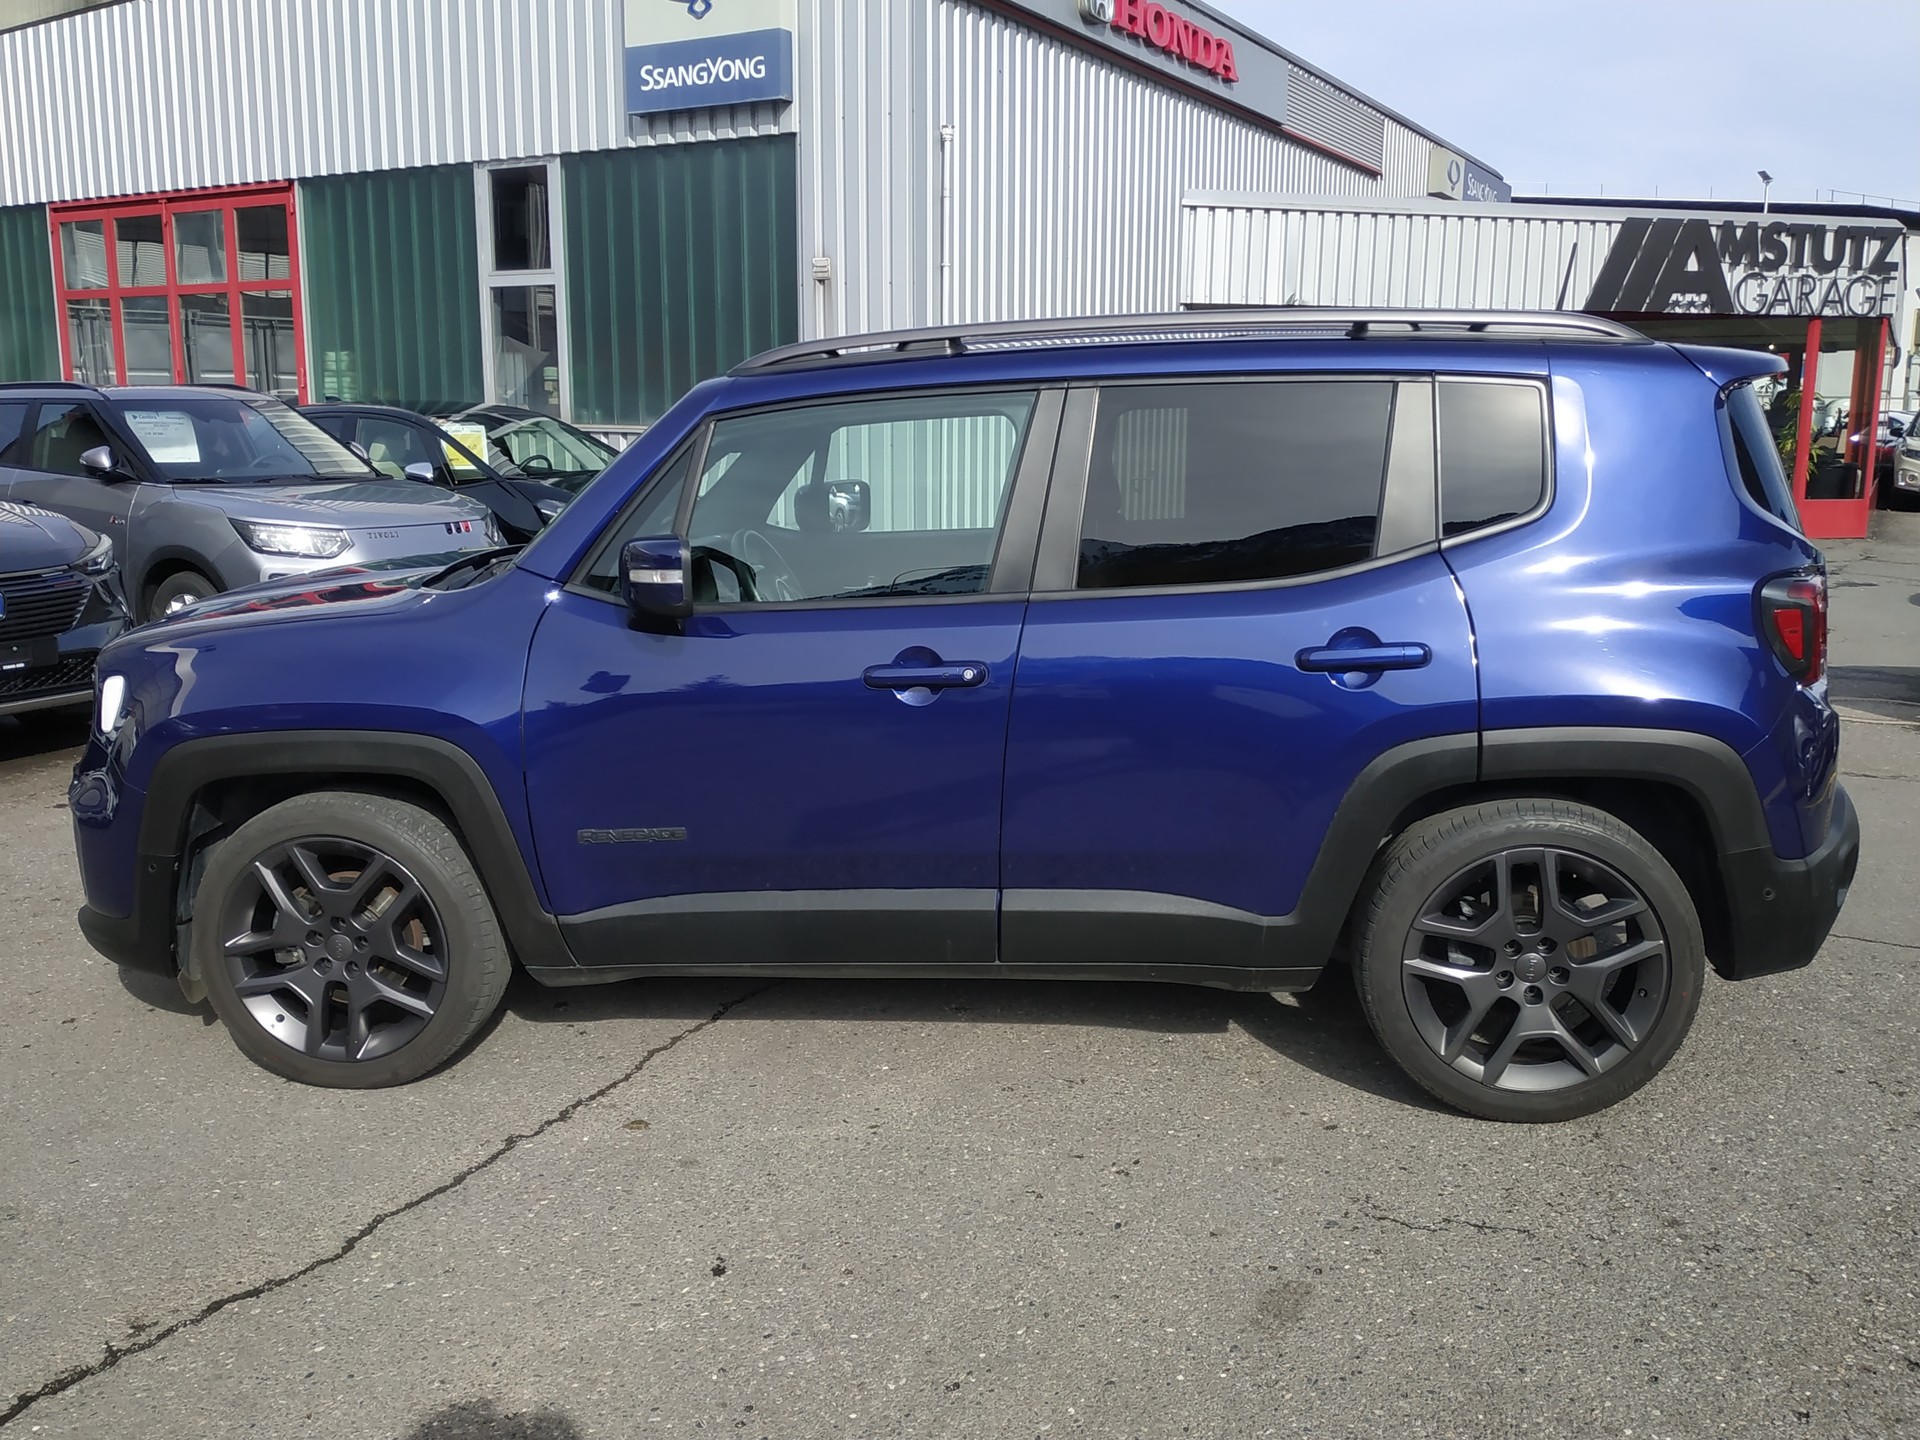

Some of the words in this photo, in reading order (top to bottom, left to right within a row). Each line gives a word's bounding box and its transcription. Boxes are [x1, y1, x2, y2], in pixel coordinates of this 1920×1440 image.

[1111, 0, 1239, 83] HONDA
[1644, 217, 1905, 313] AMSTUTZ
[1733, 271, 1898, 317] GARAGE
[367, 531, 400, 539] TIVOLI
[577, 827, 687, 844] RENEGADE
